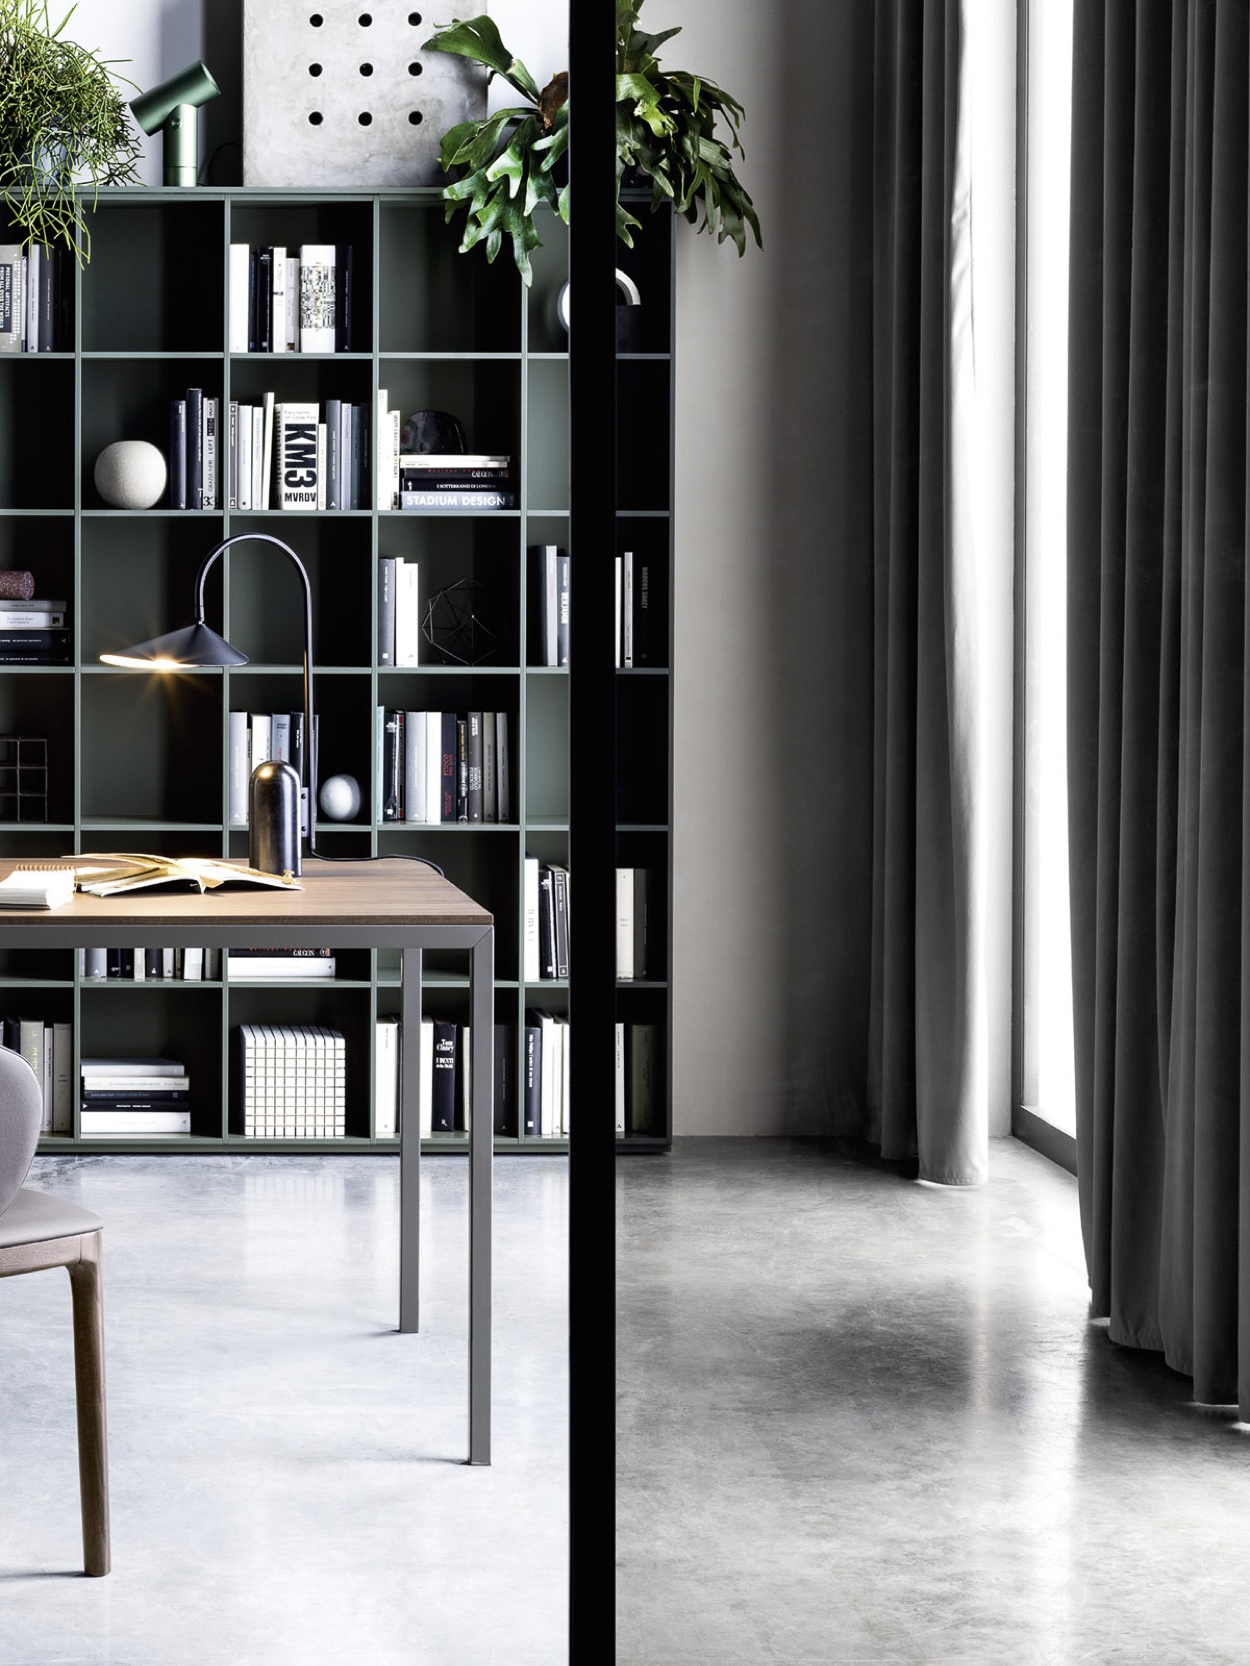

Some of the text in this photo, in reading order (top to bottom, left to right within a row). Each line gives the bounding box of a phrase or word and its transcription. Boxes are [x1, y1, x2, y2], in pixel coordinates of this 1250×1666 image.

[284, 423, 317, 488] KM3
[284, 492, 317, 503] MVRDV
[406, 495, 459, 506] STADIUM
[462, 495, 505, 506] DESIGN
